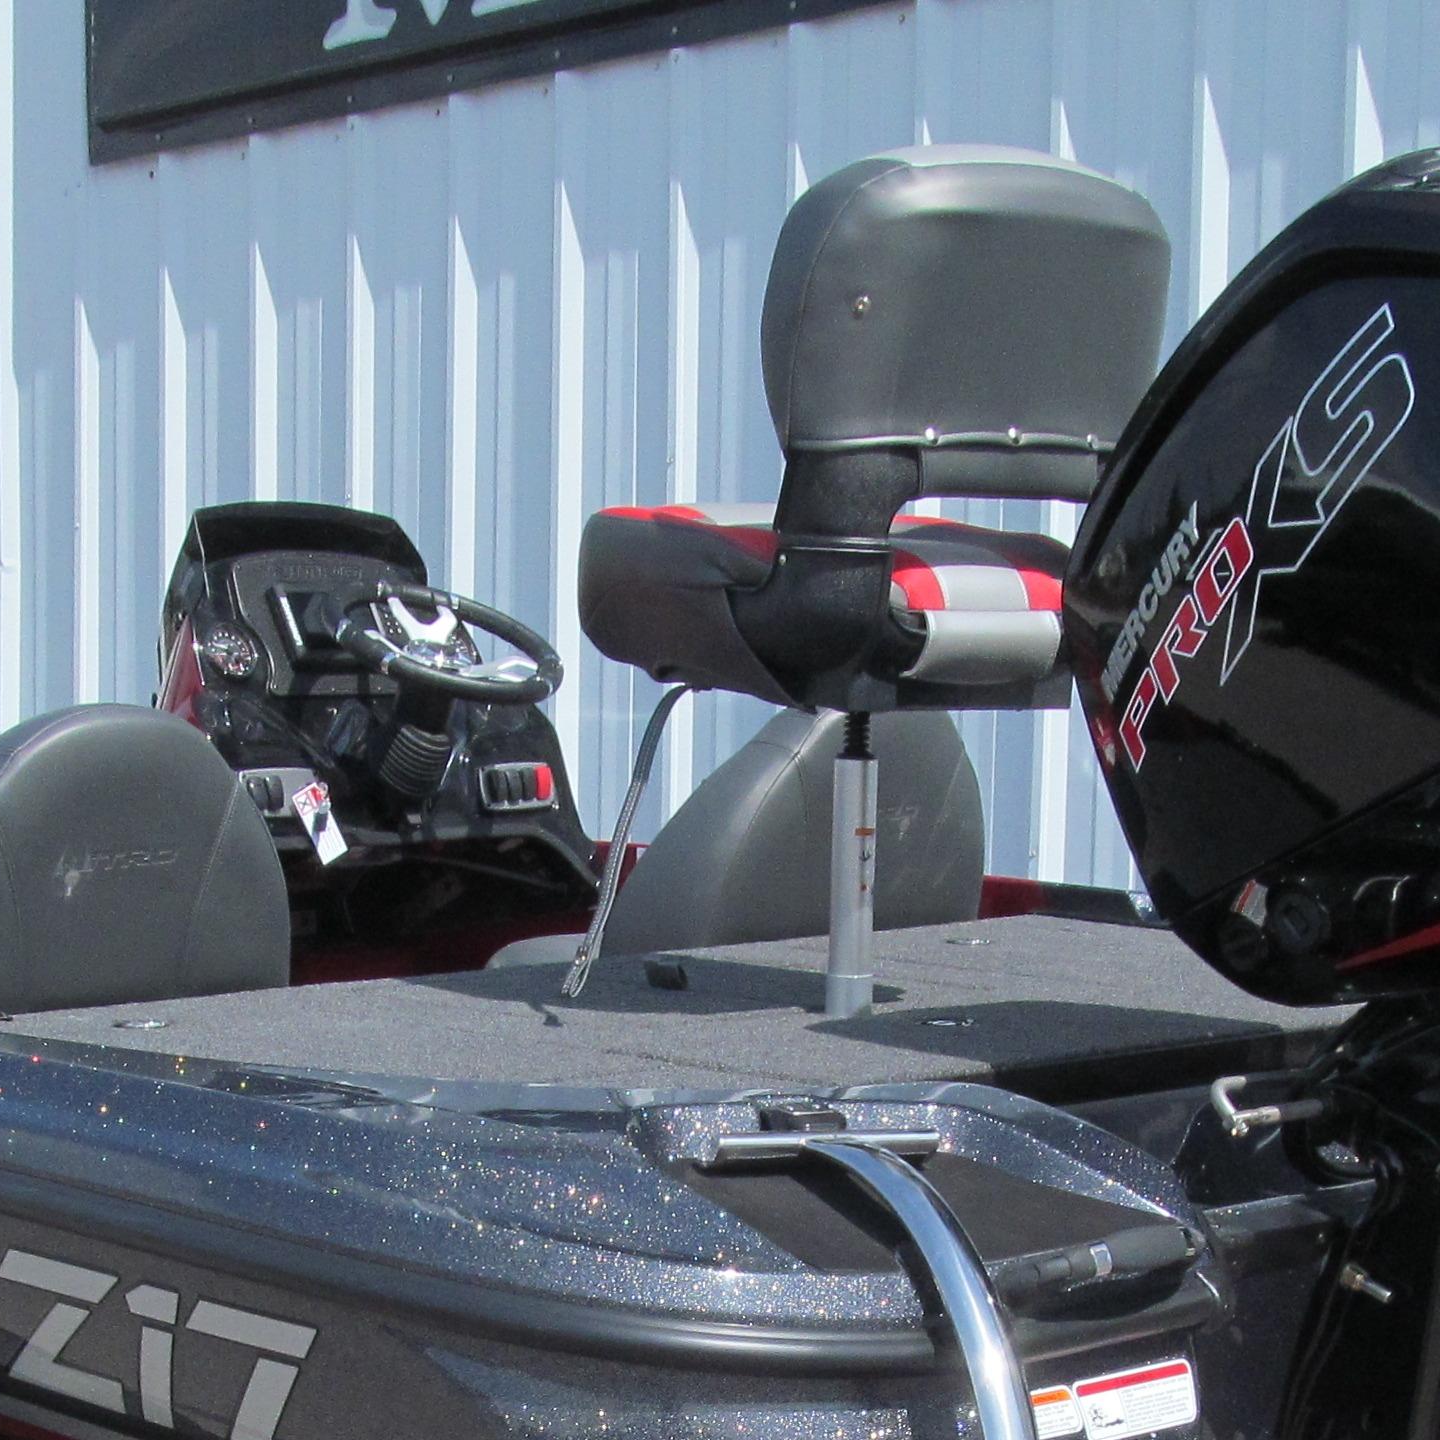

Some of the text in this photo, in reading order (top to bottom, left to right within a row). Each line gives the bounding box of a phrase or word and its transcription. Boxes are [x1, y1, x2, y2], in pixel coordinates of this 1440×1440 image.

[1101, 501, 1199, 703] MERCURY
[1119, 302, 1415, 773] PRO XS
